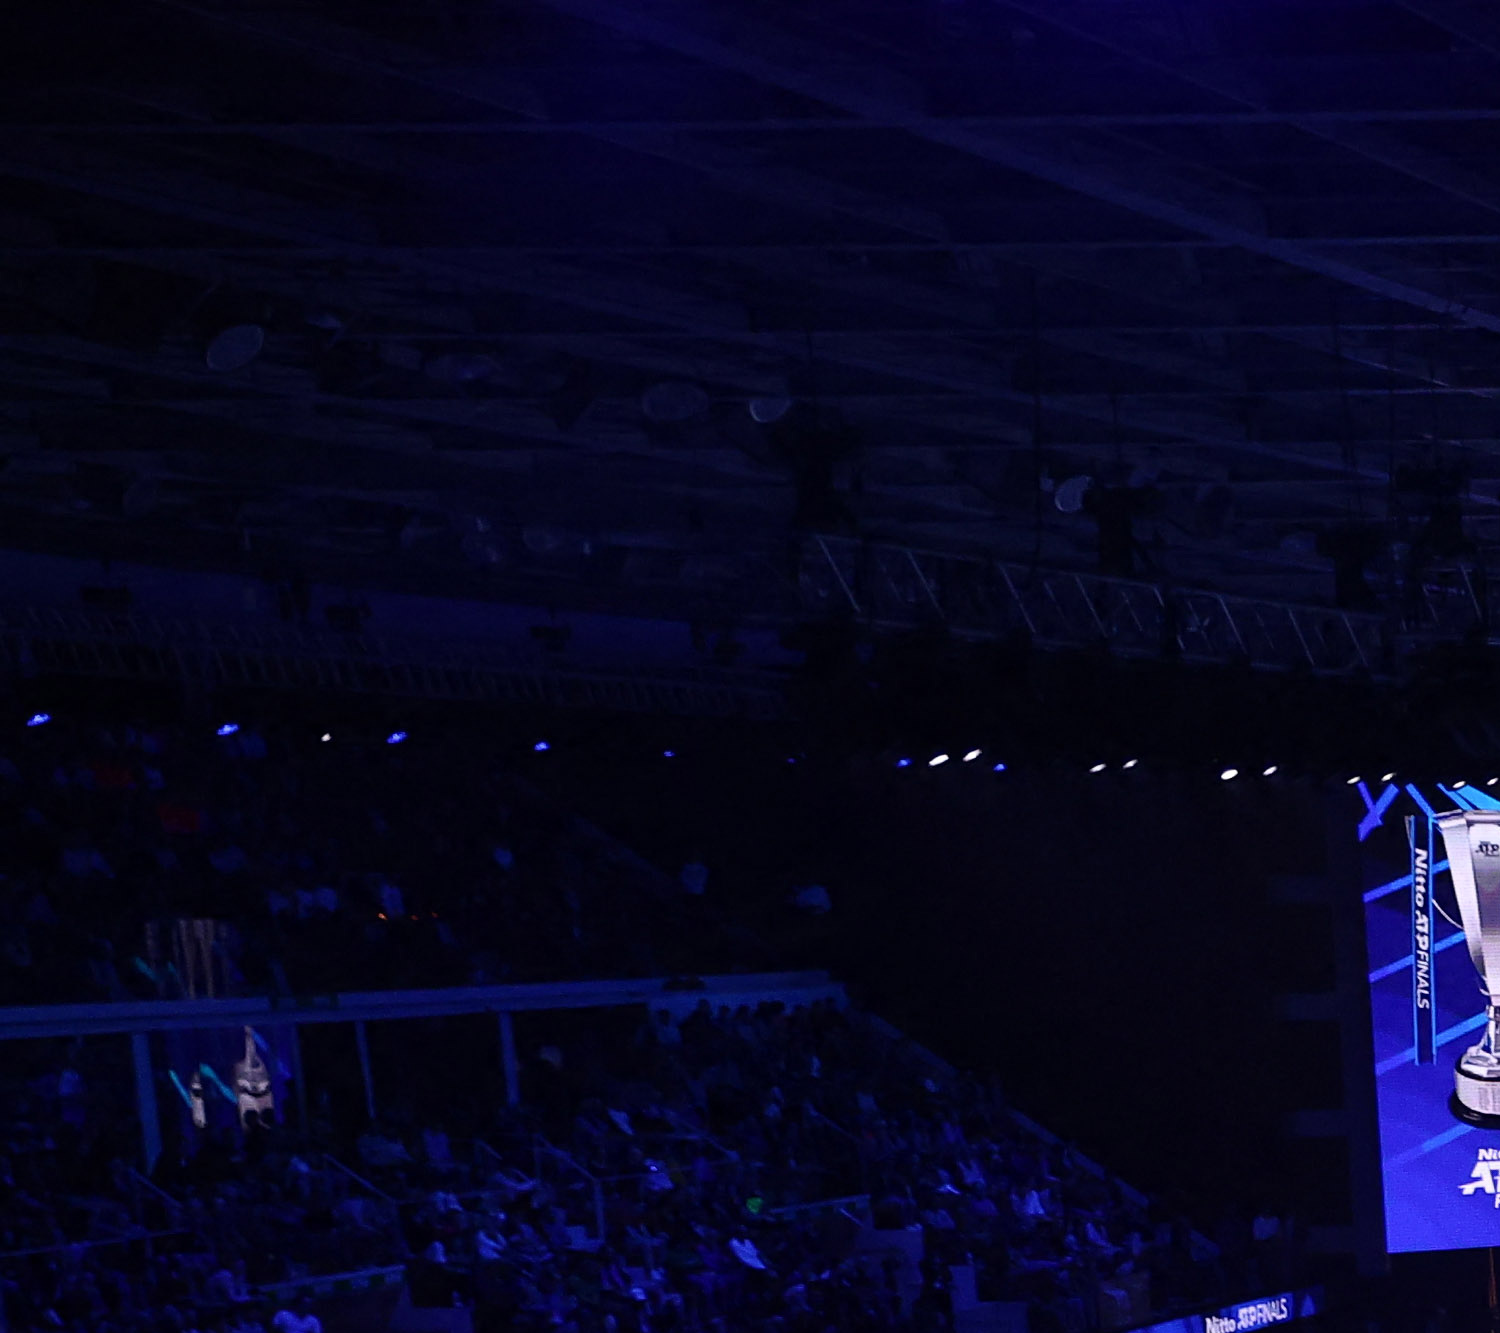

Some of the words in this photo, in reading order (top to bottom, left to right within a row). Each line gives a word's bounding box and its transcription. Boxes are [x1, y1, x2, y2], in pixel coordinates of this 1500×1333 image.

[1412, 847, 1428, 906] Nitto
[1414, 909, 1429, 951] ATP
[1416, 951, 1430, 1010] FINALS
[1256, 1297, 1288, 1326] FINALS
